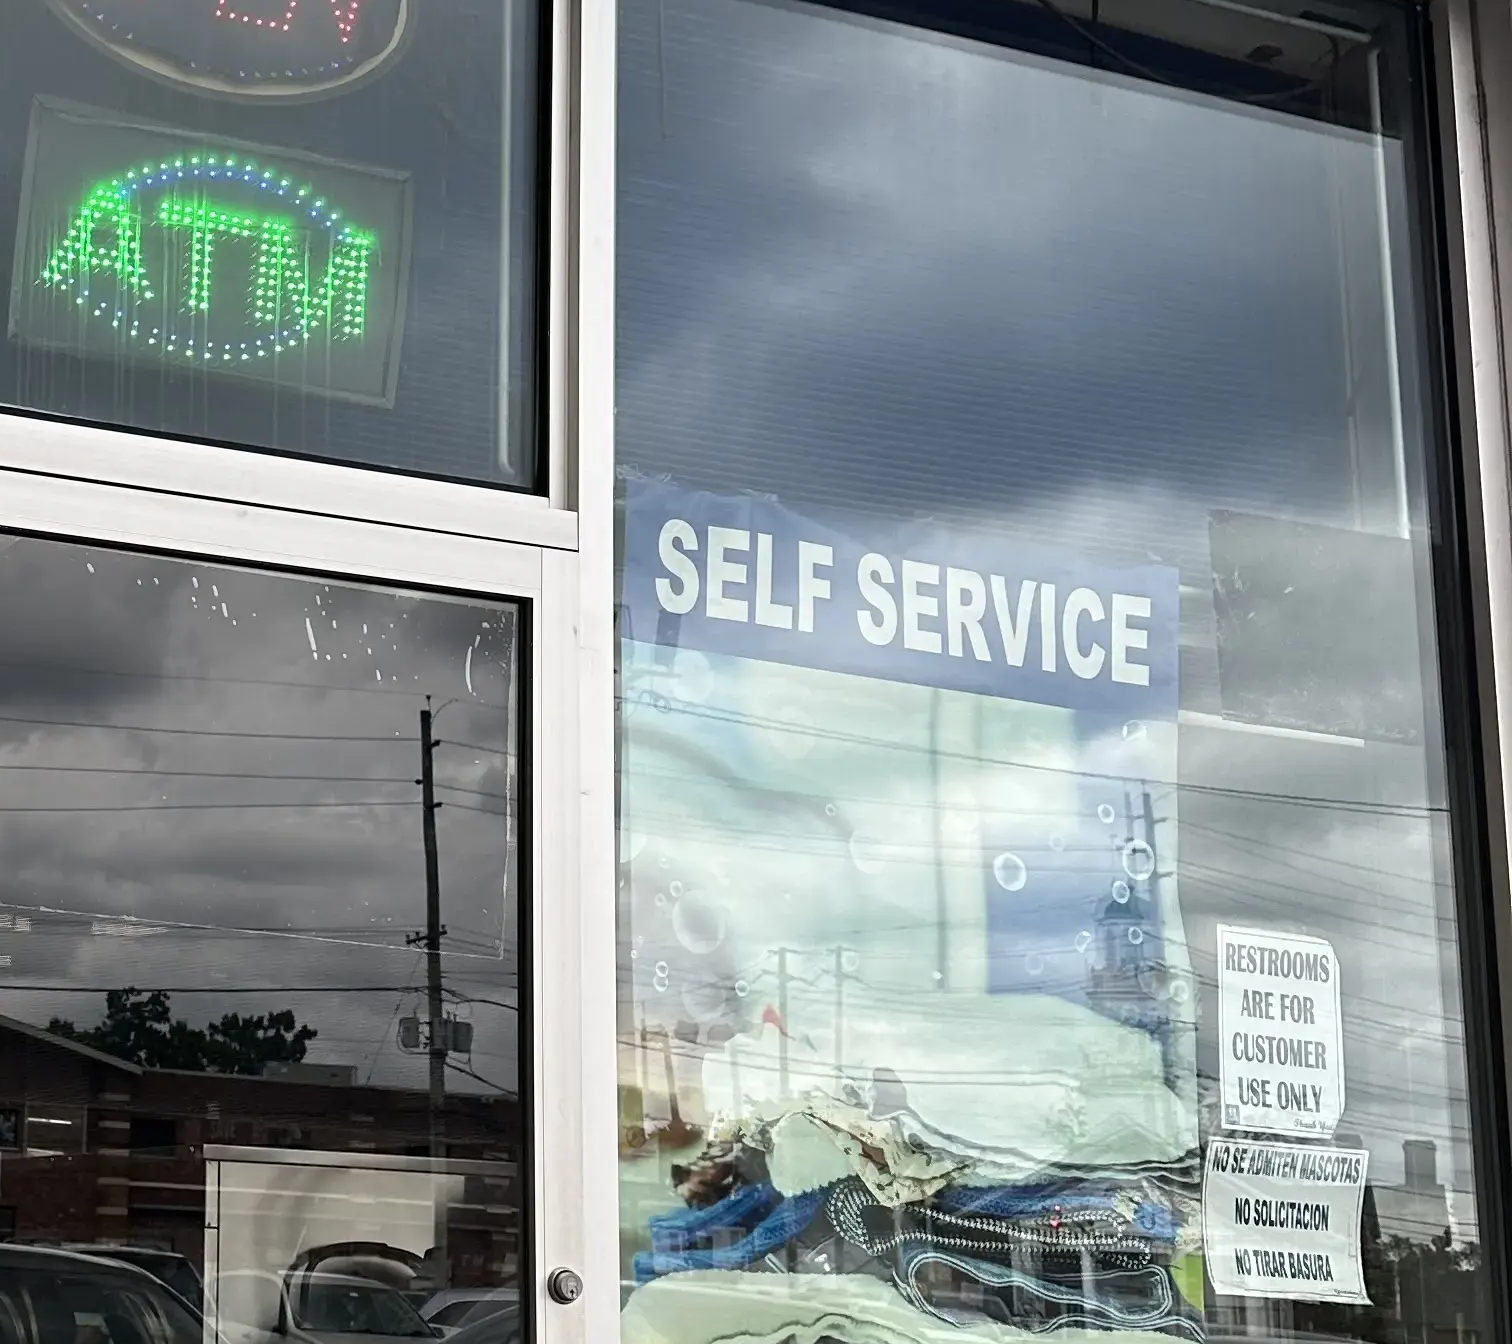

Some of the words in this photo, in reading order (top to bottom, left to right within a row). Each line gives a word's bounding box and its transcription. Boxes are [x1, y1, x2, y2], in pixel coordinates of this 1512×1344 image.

[40, 184, 377, 338] ATM
[655, 518, 834, 633] SELF
[856, 552, 1152, 687] SERVICE
[1225, 942, 1330, 983] RESTROOMS
[1241, 989, 1275, 1021] ARE
[1280, 993, 1315, 1025] FOR
[1232, 1031, 1327, 1070] CUSTOMER
[1238, 1076, 1272, 1108] USE
[1277, 1081, 1322, 1113] ONLY
[1212, 1145, 1230, 1173] NO
[1231, 1147, 1247, 1174] SE
[1247, 1149, 1299, 1179] ADMITEN
[1299, 1153, 1361, 1185] MASCOTAS
[1235, 1197, 1250, 1225] NO
[1253, 1199, 1329, 1232] SOLICITACION
[1234, 1248, 1251, 1276] NO
[1253, 1249, 1288, 1279] TIRAR
[1288, 1252, 1334, 1283] BASURA
